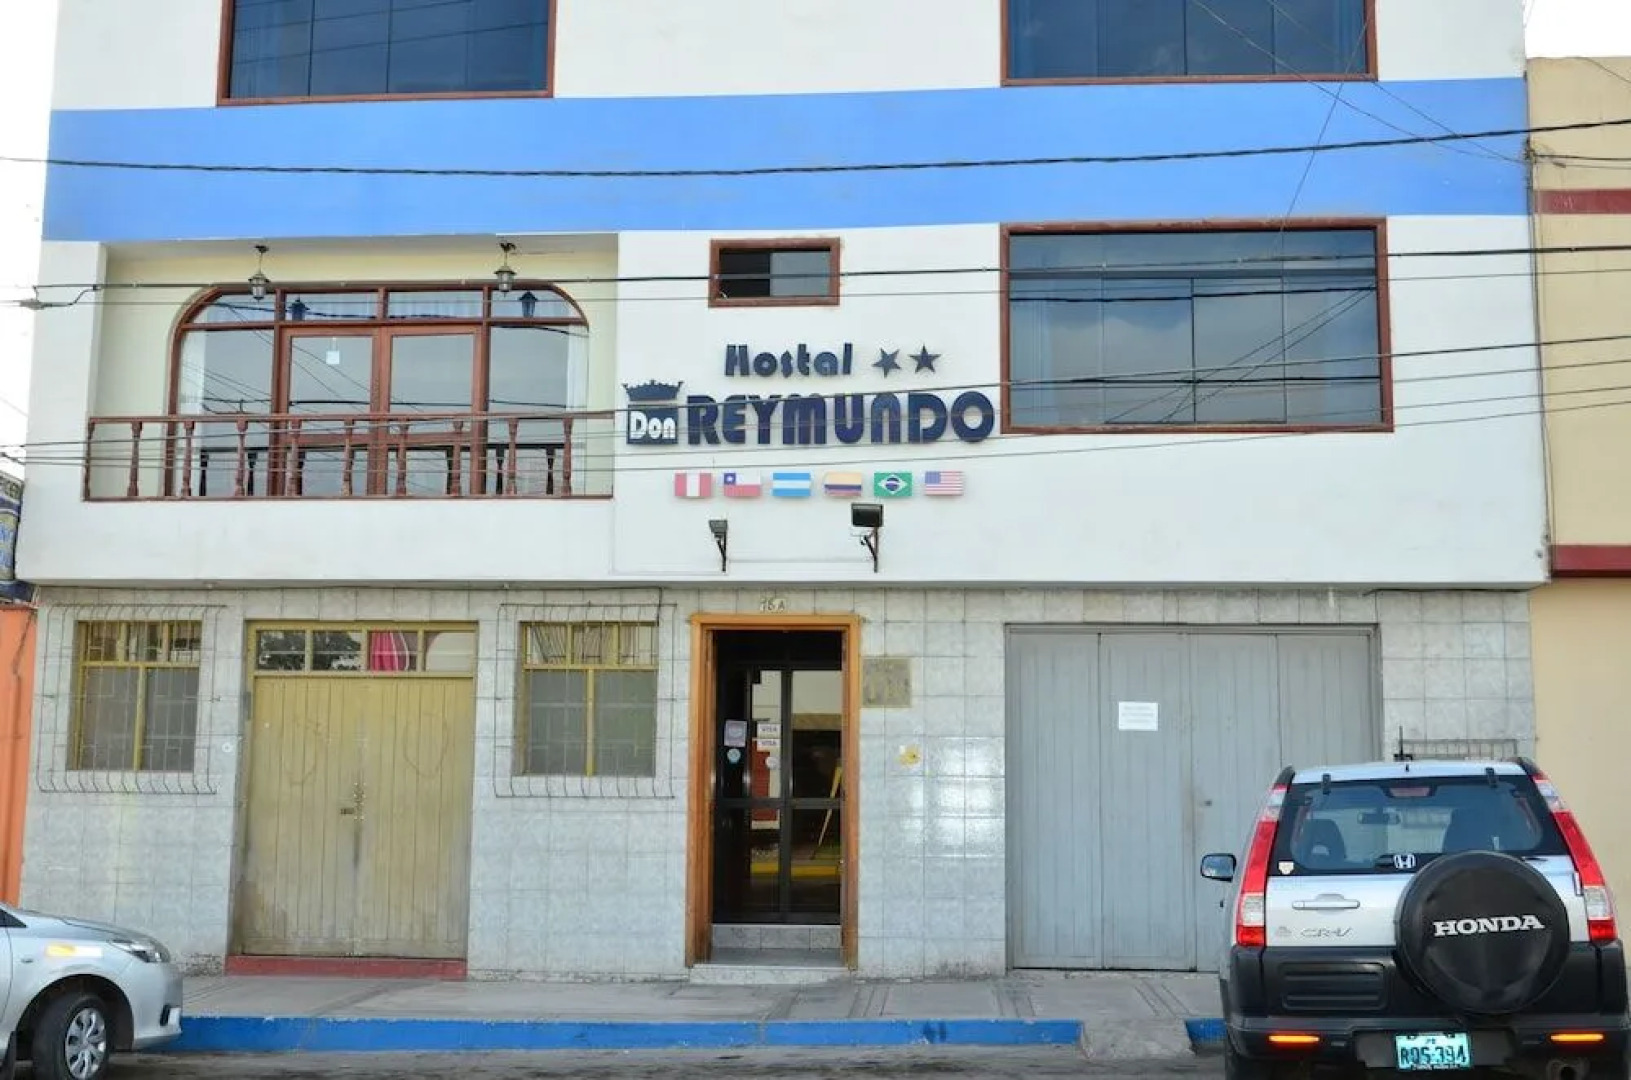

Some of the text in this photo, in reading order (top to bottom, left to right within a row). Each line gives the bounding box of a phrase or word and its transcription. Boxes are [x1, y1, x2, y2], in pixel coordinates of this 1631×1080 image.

[725, 343, 853, 378] Hostal
[629, 391, 995, 445] Don REYMUNDO
[1433, 914, 1545, 937] HONDA
